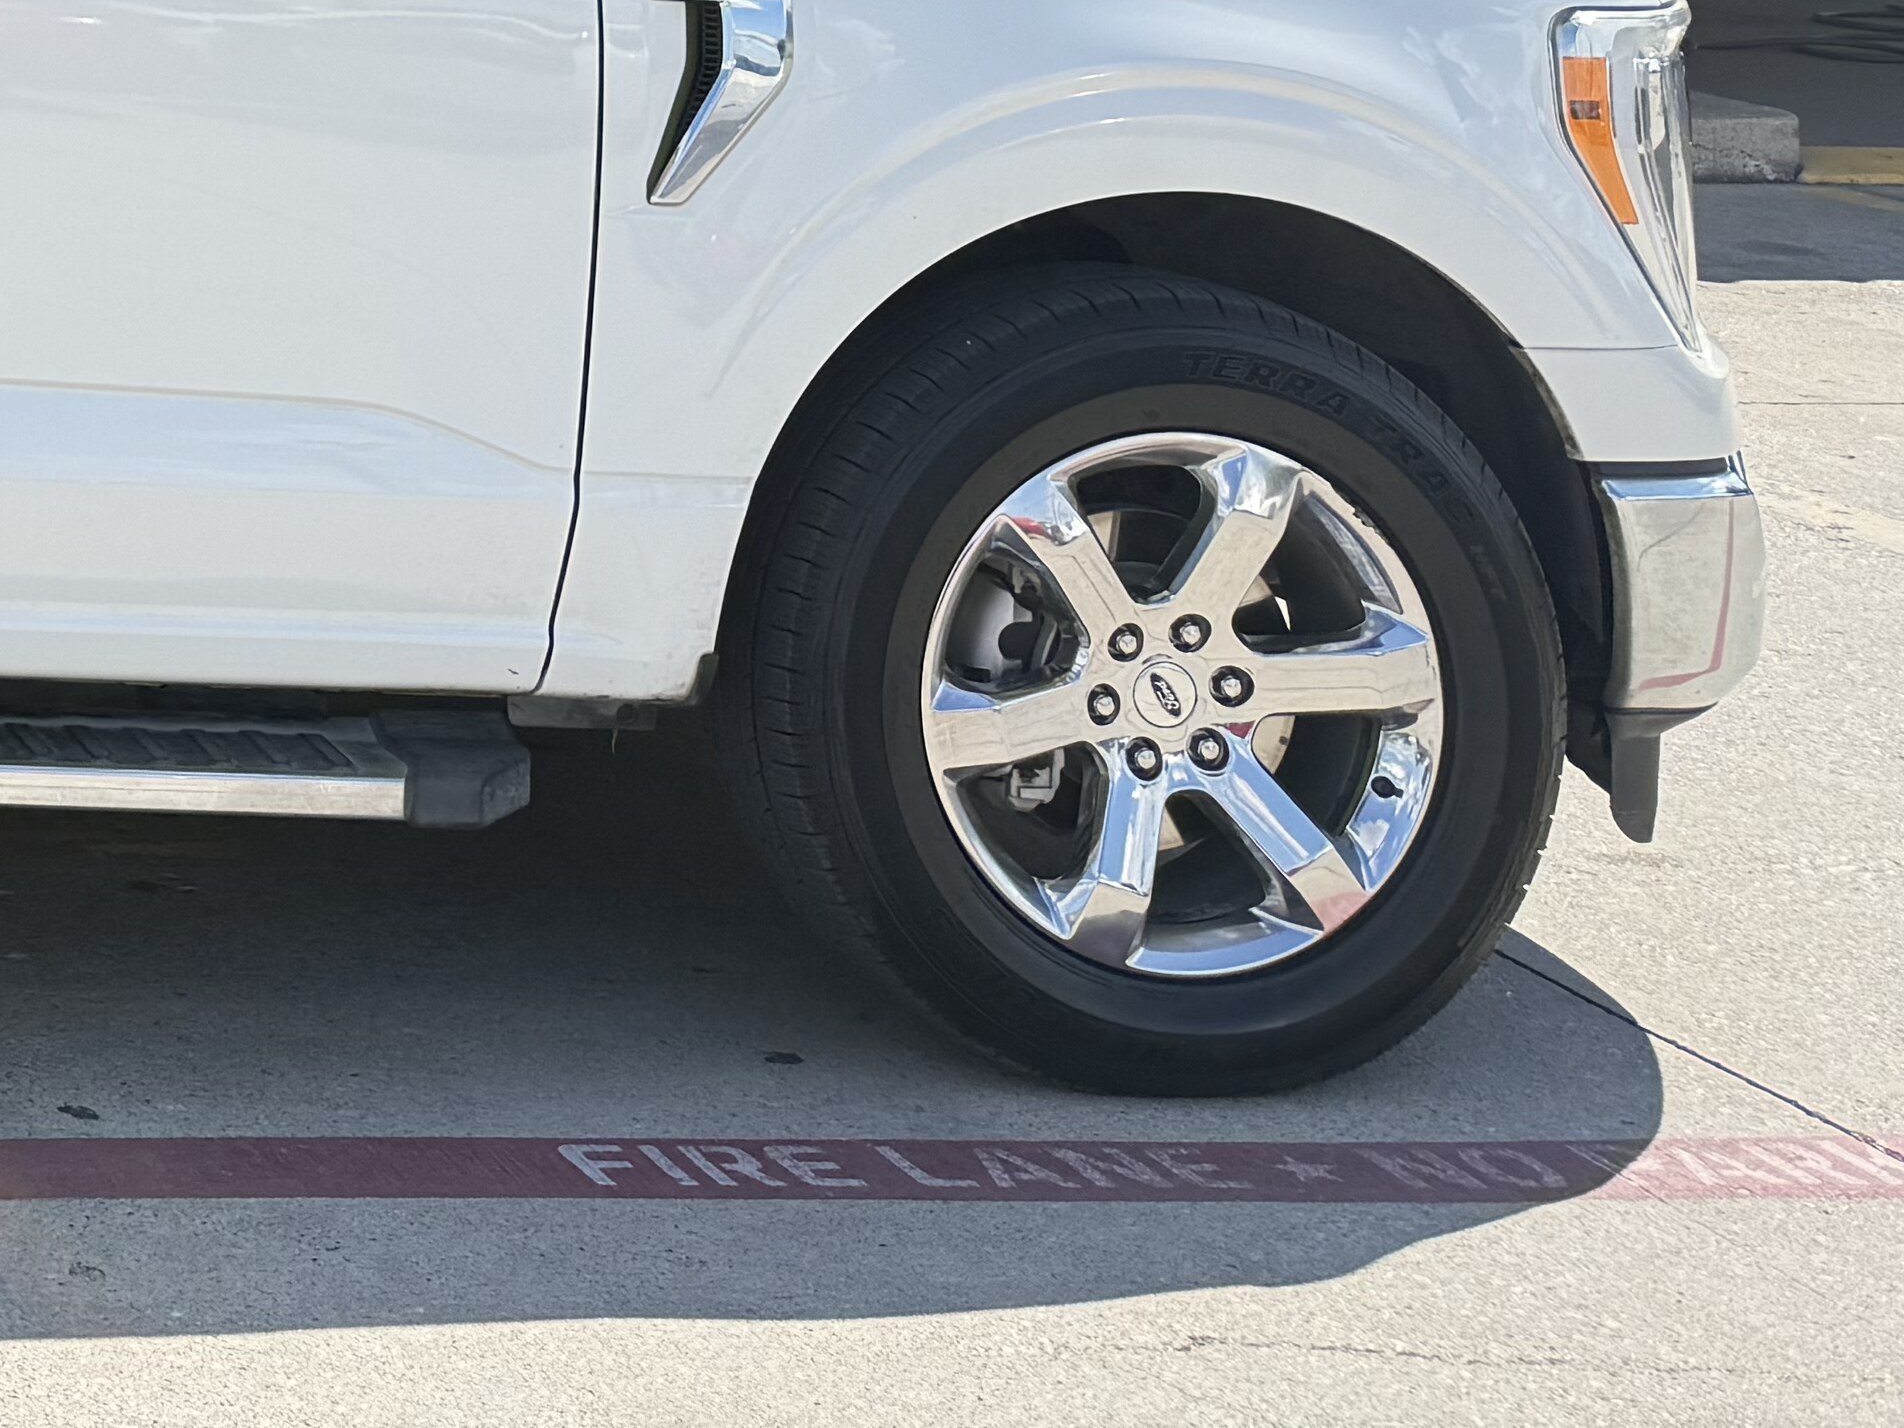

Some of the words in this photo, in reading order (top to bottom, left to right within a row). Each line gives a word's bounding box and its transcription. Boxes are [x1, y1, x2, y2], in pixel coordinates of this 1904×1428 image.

[1183, 351, 1350, 416] TERRA
[558, 1144, 868, 1187] FIRE
[874, 1145, 1255, 1188] LANE
[1357, 1147, 1568, 1188] NO
